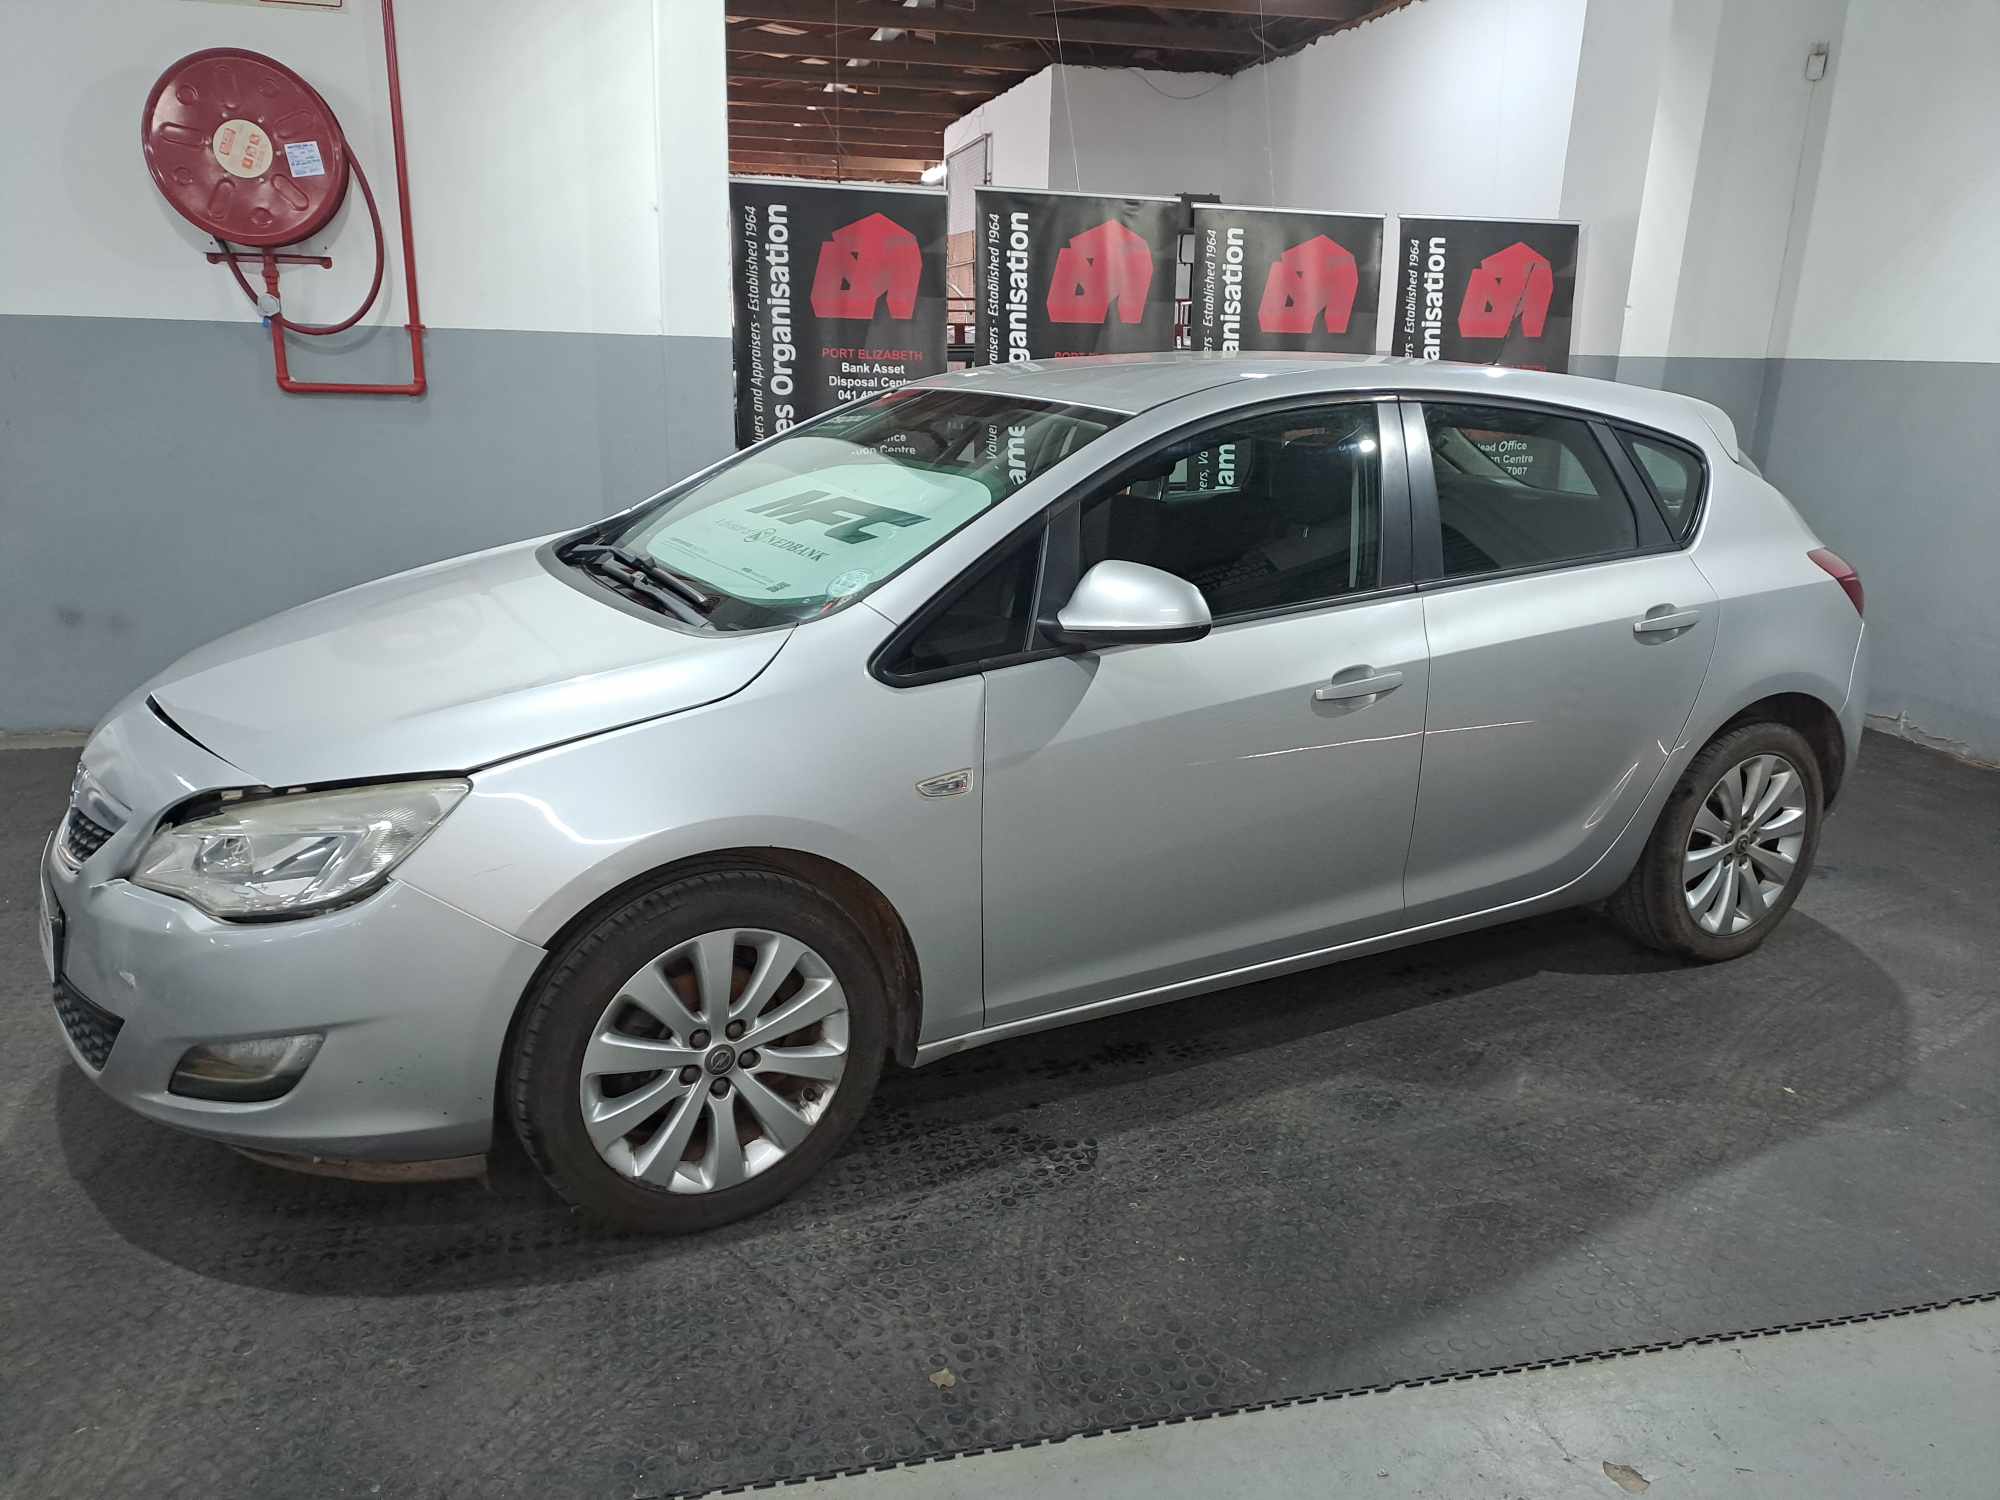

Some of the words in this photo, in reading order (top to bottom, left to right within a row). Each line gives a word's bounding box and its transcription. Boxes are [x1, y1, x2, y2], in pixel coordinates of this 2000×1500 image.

[744, 205, 757, 236] 1964
[988, 213, 1000, 244] 1964
[1206, 229, 1217, 258] 1964
[1409, 239, 1420, 266] 1964
[745, 240, 760, 311] Established
[987, 246, 1000, 316] Established
[765, 204, 797, 395] Organisation
[1203, 260, 1216, 327] Established
[1404, 270, 1418, 333] Established
[749, 321, 766, 386] Appraisers
[822, 347, 857, 359] PORT
[858, 349, 923, 361] ELIZABETH
[841, 362, 870, 374] Bank
[873, 363, 905, 374] Asset
[828, 375, 877, 388] Disposal
[838, 389, 857, 400] 041
[750, 387, 764, 413] and
[880, 445, 915, 455] Centre
[1498, 440, 1527, 452] Office
[1502, 455, 1534, 464] Centre
[764, 533, 831, 562] NEDBANK
